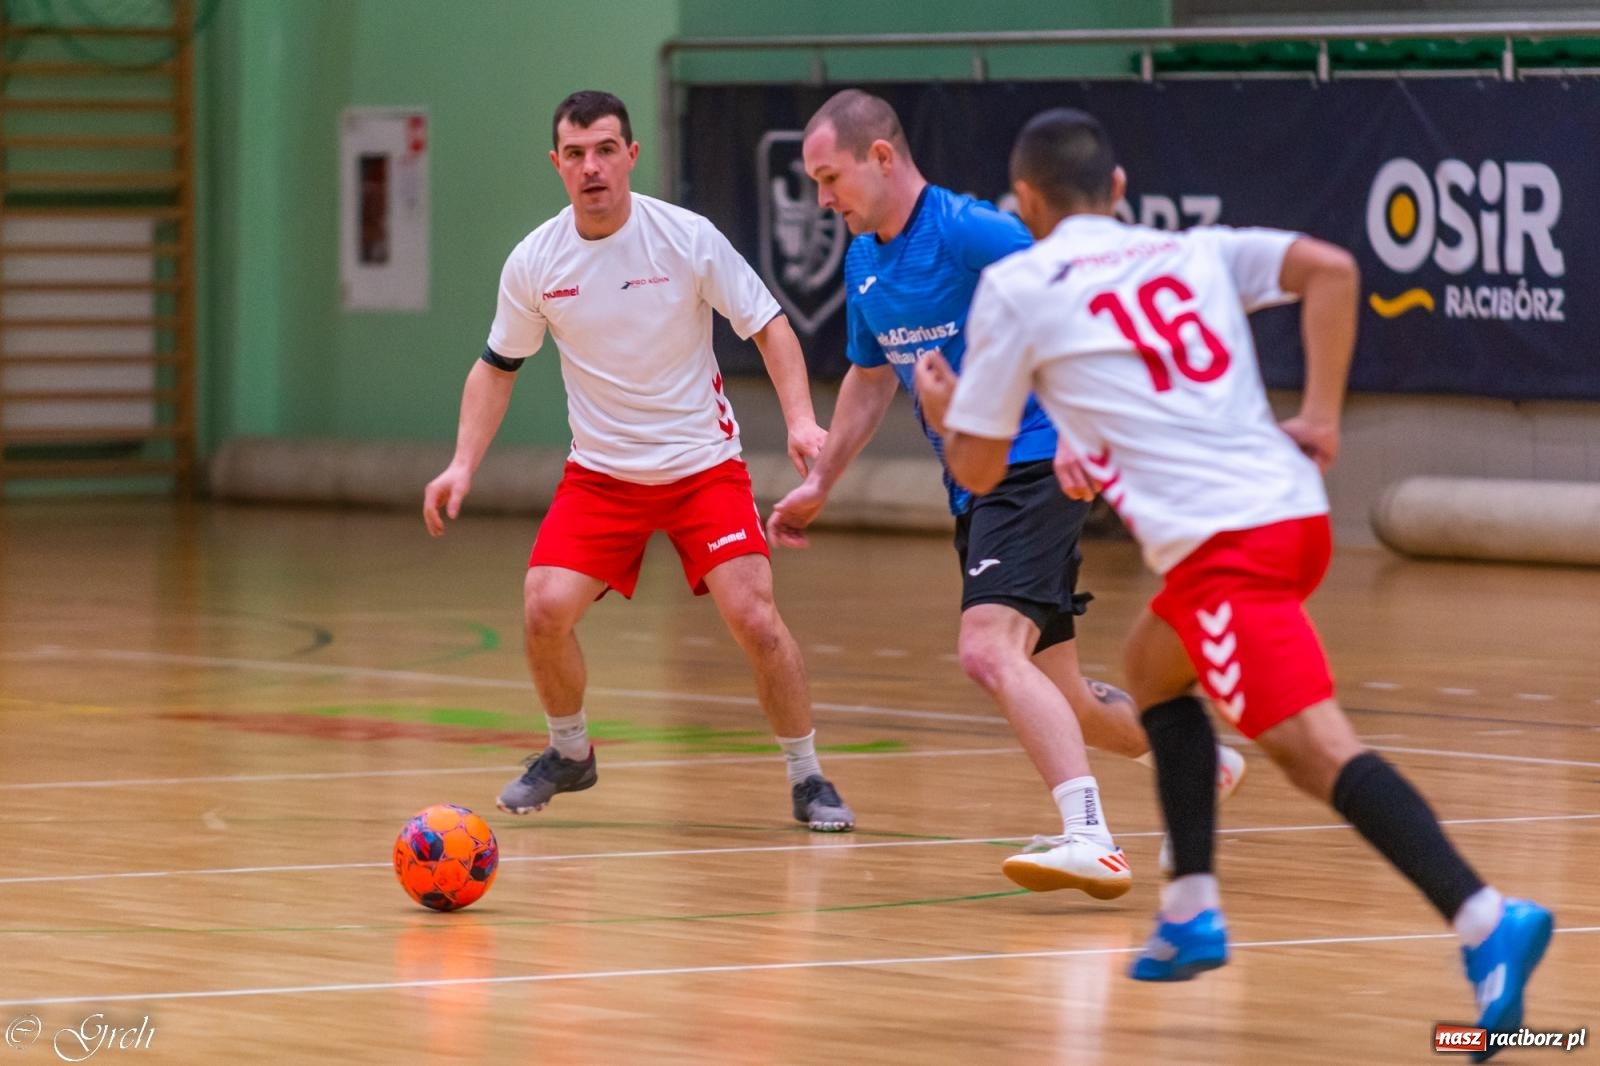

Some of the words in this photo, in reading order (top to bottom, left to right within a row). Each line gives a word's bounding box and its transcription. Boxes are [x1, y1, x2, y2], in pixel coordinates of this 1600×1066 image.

[1445, 278, 1565, 321] RACIBÓRZ
[1089, 275, 1230, 393] 16
[707, 528, 747, 553] hummel
